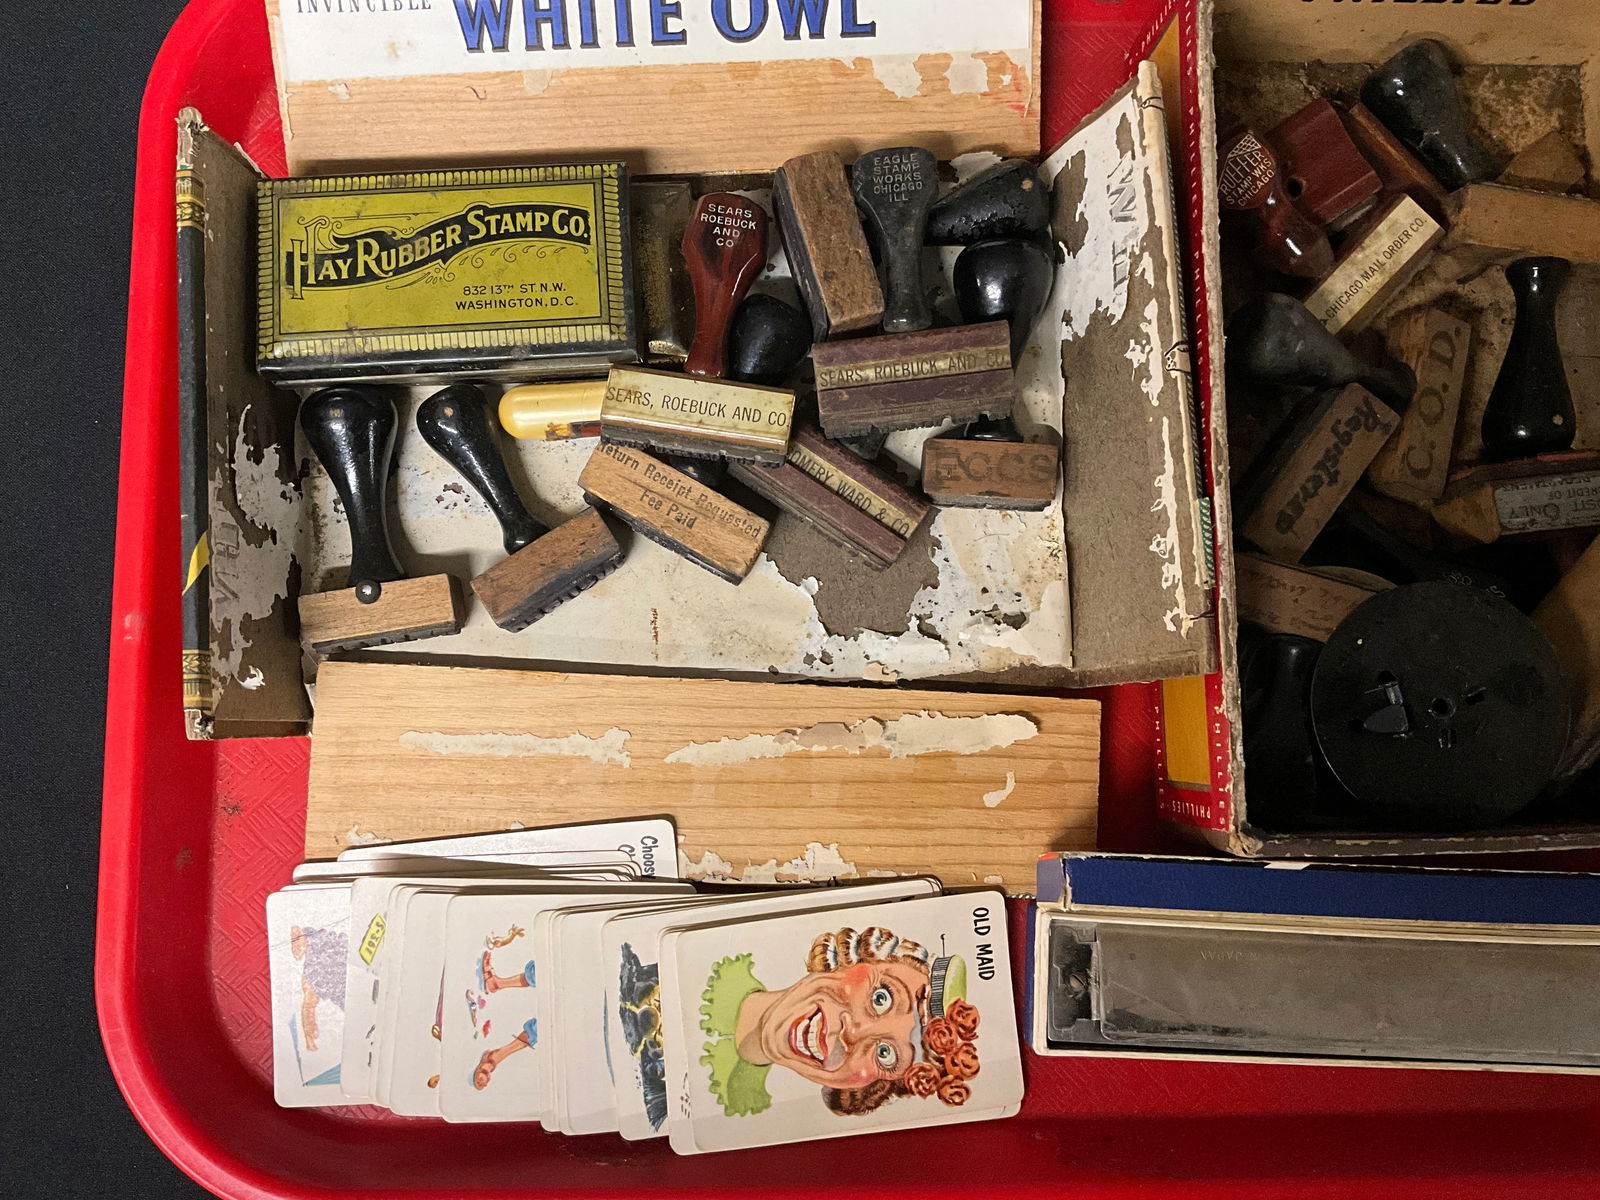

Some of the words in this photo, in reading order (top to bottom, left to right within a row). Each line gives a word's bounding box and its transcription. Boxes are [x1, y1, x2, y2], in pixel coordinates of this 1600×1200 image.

[297, 0, 432, 13] INVINCIBLE
[710, 0, 877, 44] OWL
[873, 162, 920, 175] STAMP
[874, 153, 918, 166] EAGLE
[1220, 150, 1265, 196] RUEFFER
[873, 172, 922, 184] WORKS
[873, 181, 923, 194] CHICAGO
[1226, 176, 1252, 205] STAMP
[1251, 158, 1272, 178] WKS
[1237, 169, 1275, 207] CHICAGO
[700, 212, 757, 230] ROEBUCK
[707, 203, 752, 218] SEARS
[713, 226, 740, 238] AND
[716, 237, 734, 248] CO
[290, 216, 354, 300] HAY
[355, 223, 463, 278] RUBBER
[466, 209, 550, 241] STAMP
[551, 208, 588, 238] CO.
[1324, 279, 1364, 320] CHICAGO
[1360, 258, 1387, 283] MAIL
[1382, 228, 1413, 260] ORDER
[1409, 216, 1428, 234] CO.
[463, 285, 487, 296] 832
[874, 359, 938, 381] ROEBUCK
[949, 353, 977, 370] AND
[605, 386, 654, 410] SEARS,
[661, 395, 727, 418] ROEBUCK
[732, 405, 762, 423] AND
[643, 462, 692, 500] Receipt
[788, 450, 834, 486] OMERY
[836, 479, 872, 511] WARD
[874, 507, 887, 521] &
[640, 489, 663, 511] Fee
[666, 503, 698, 530] Paid
[972, 906, 991, 937] OLD
[975, 943, 996, 982] MAID
